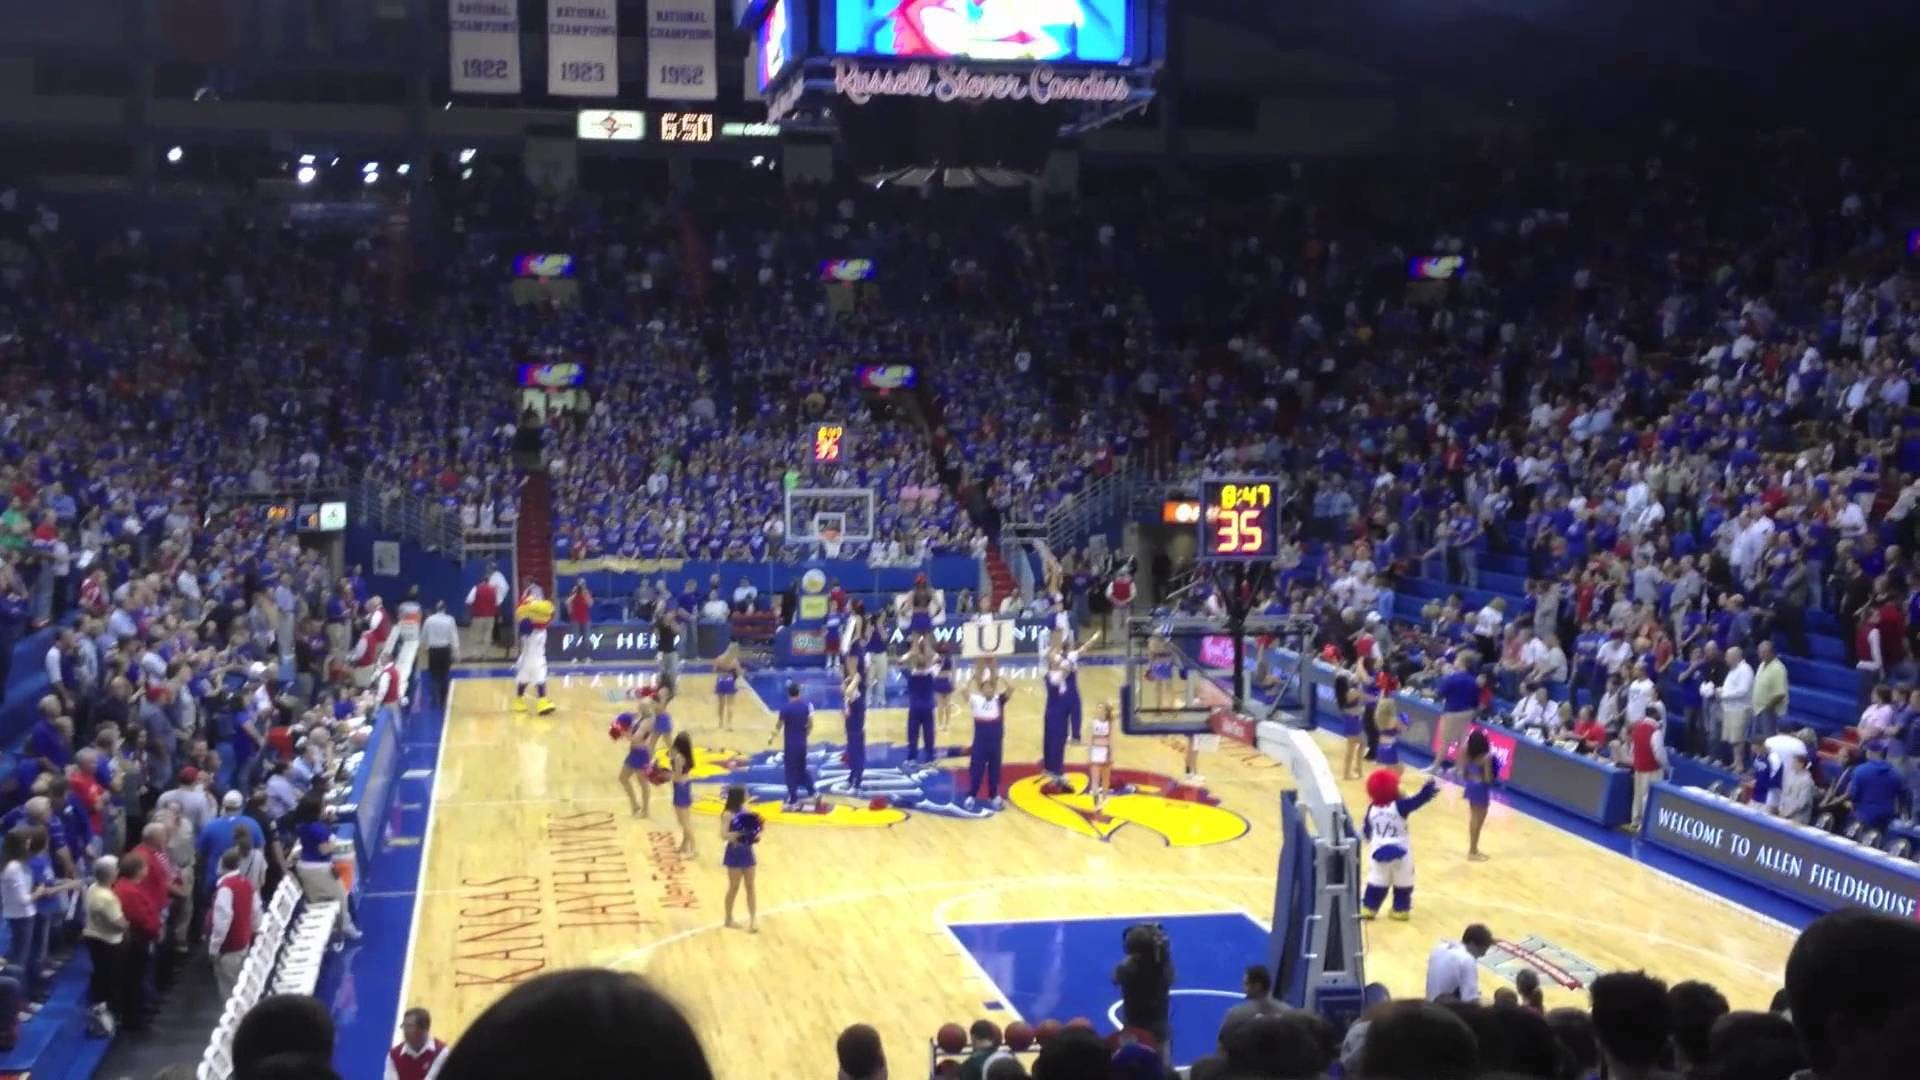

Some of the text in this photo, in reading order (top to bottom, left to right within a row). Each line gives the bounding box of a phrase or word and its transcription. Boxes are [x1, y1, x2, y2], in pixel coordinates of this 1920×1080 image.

[462, 59, 508, 79] 1922
[561, 62, 606, 82] 1923
[661, 64, 705, 85] 1952
[832, 58, 1131, 104] Russell Stover Candies
[661, 112, 713, 141] 6:50
[1221, 484, 1271, 510] 8:47
[1217, 510, 1262, 552] 35
[562, 633, 604, 651] PY
[978, 625, 1002, 652] U
[1376, 821, 1399, 839] 1/2
[547, 810, 664, 929] JAYHAWKS
[1657, 807, 1917, 917] WELCOME TO ALLEN FIELDHOUSE
[455, 875, 545, 988] KANSAS
